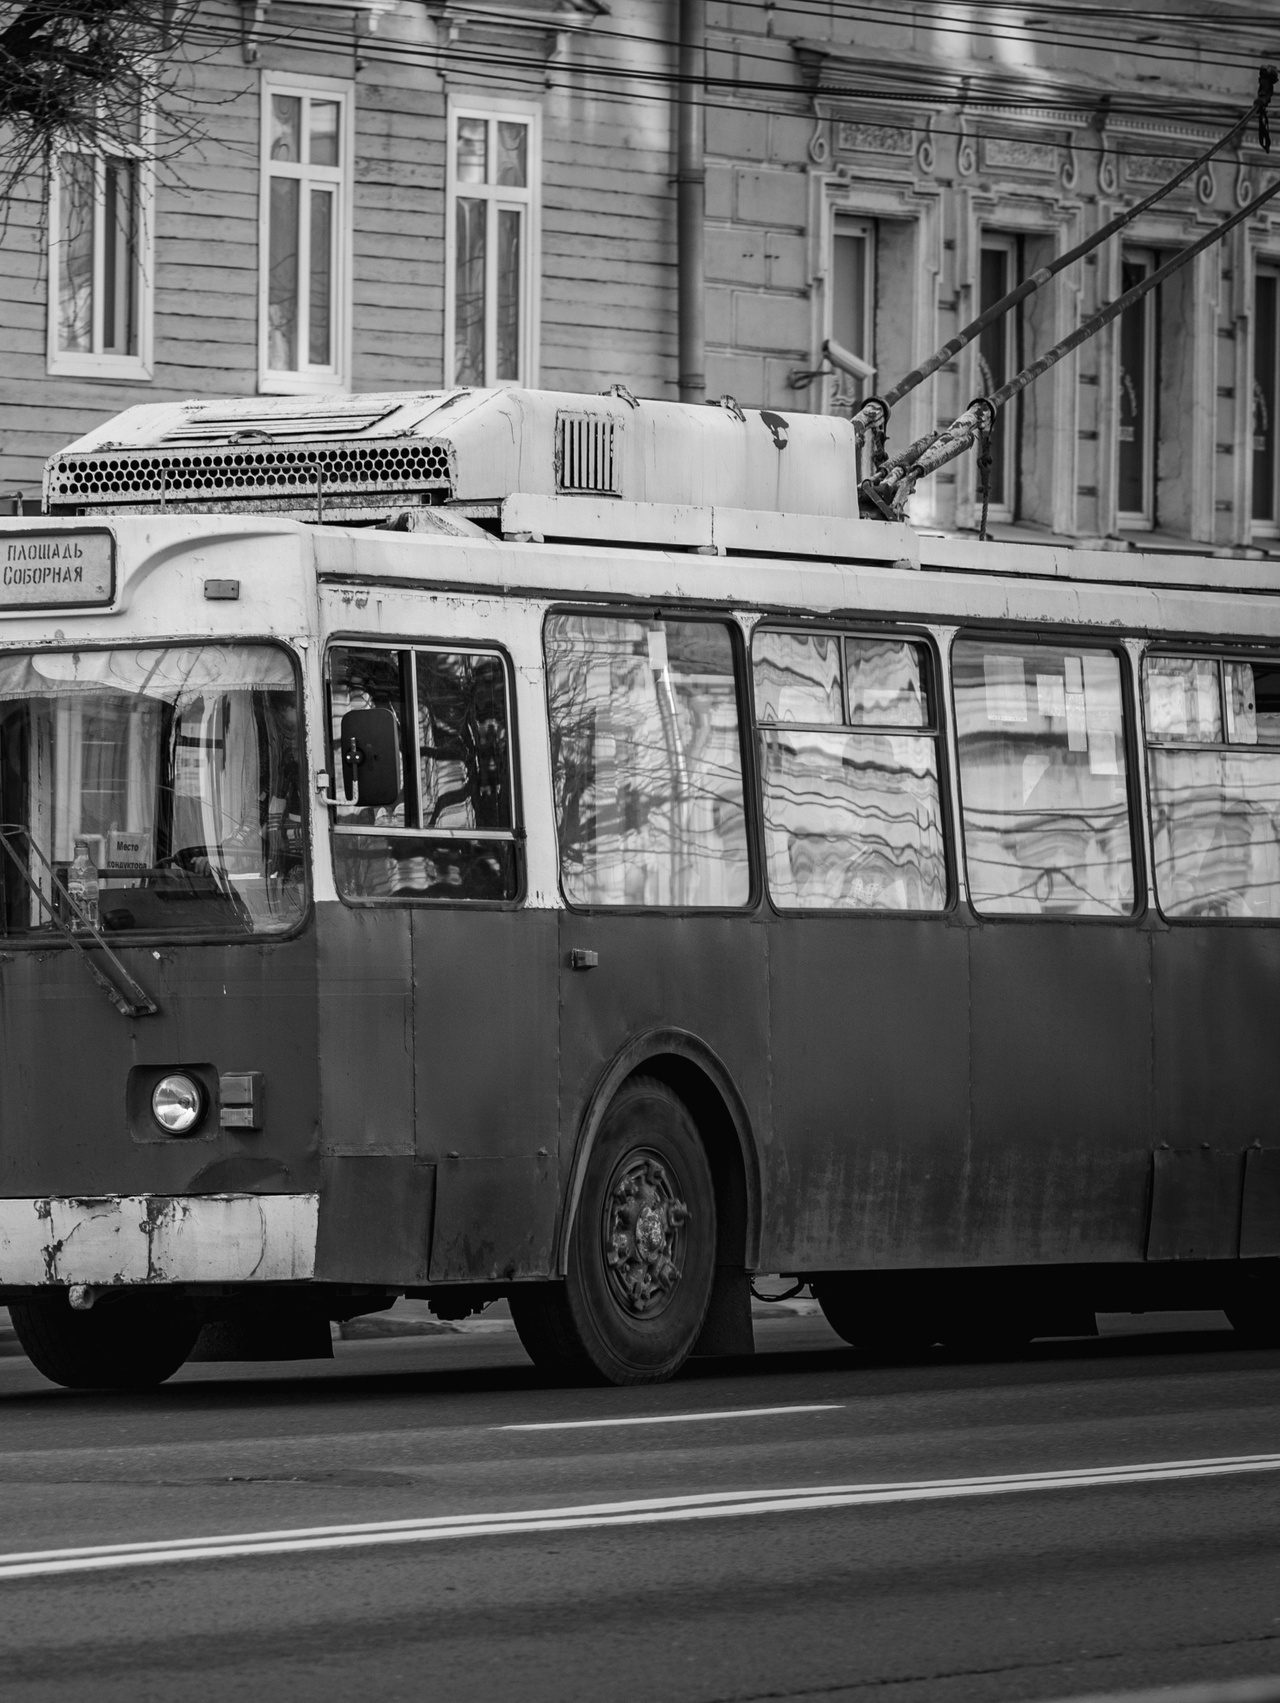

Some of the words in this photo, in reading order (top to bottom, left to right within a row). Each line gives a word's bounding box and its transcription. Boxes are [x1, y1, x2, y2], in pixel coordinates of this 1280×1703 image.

[7, 543, 84, 562] ПЛОЩАДЬ
[3, 565, 84, 586] СОБОРНАЯ
[116, 841, 139, 852] Место
